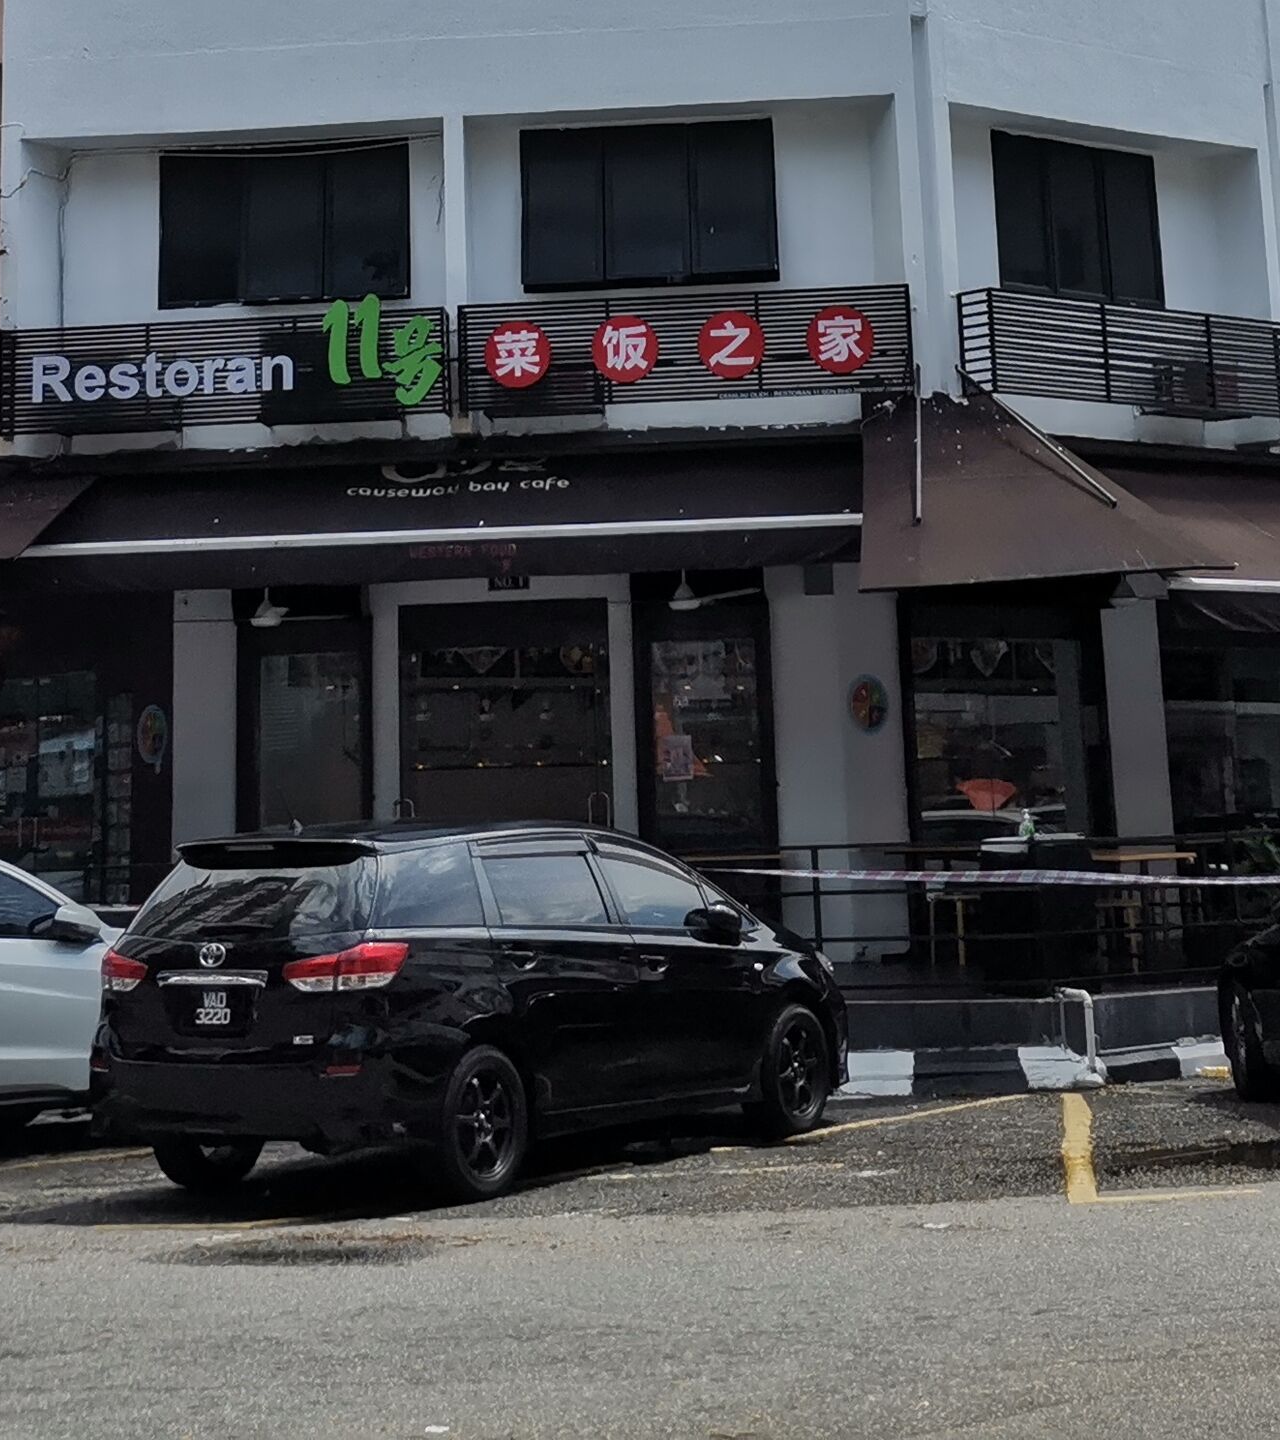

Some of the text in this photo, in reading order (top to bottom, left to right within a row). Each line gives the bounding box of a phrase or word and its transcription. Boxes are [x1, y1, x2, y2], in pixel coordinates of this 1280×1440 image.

[492, 315, 865, 378] 菜饭之家
[31, 351, 294, 404] Restoran
[469, 480, 510, 494] bay
[519, 475, 570, 491] cafe
[203, 991, 227, 1008] VAD
[195, 1008, 231, 1024] 3220
